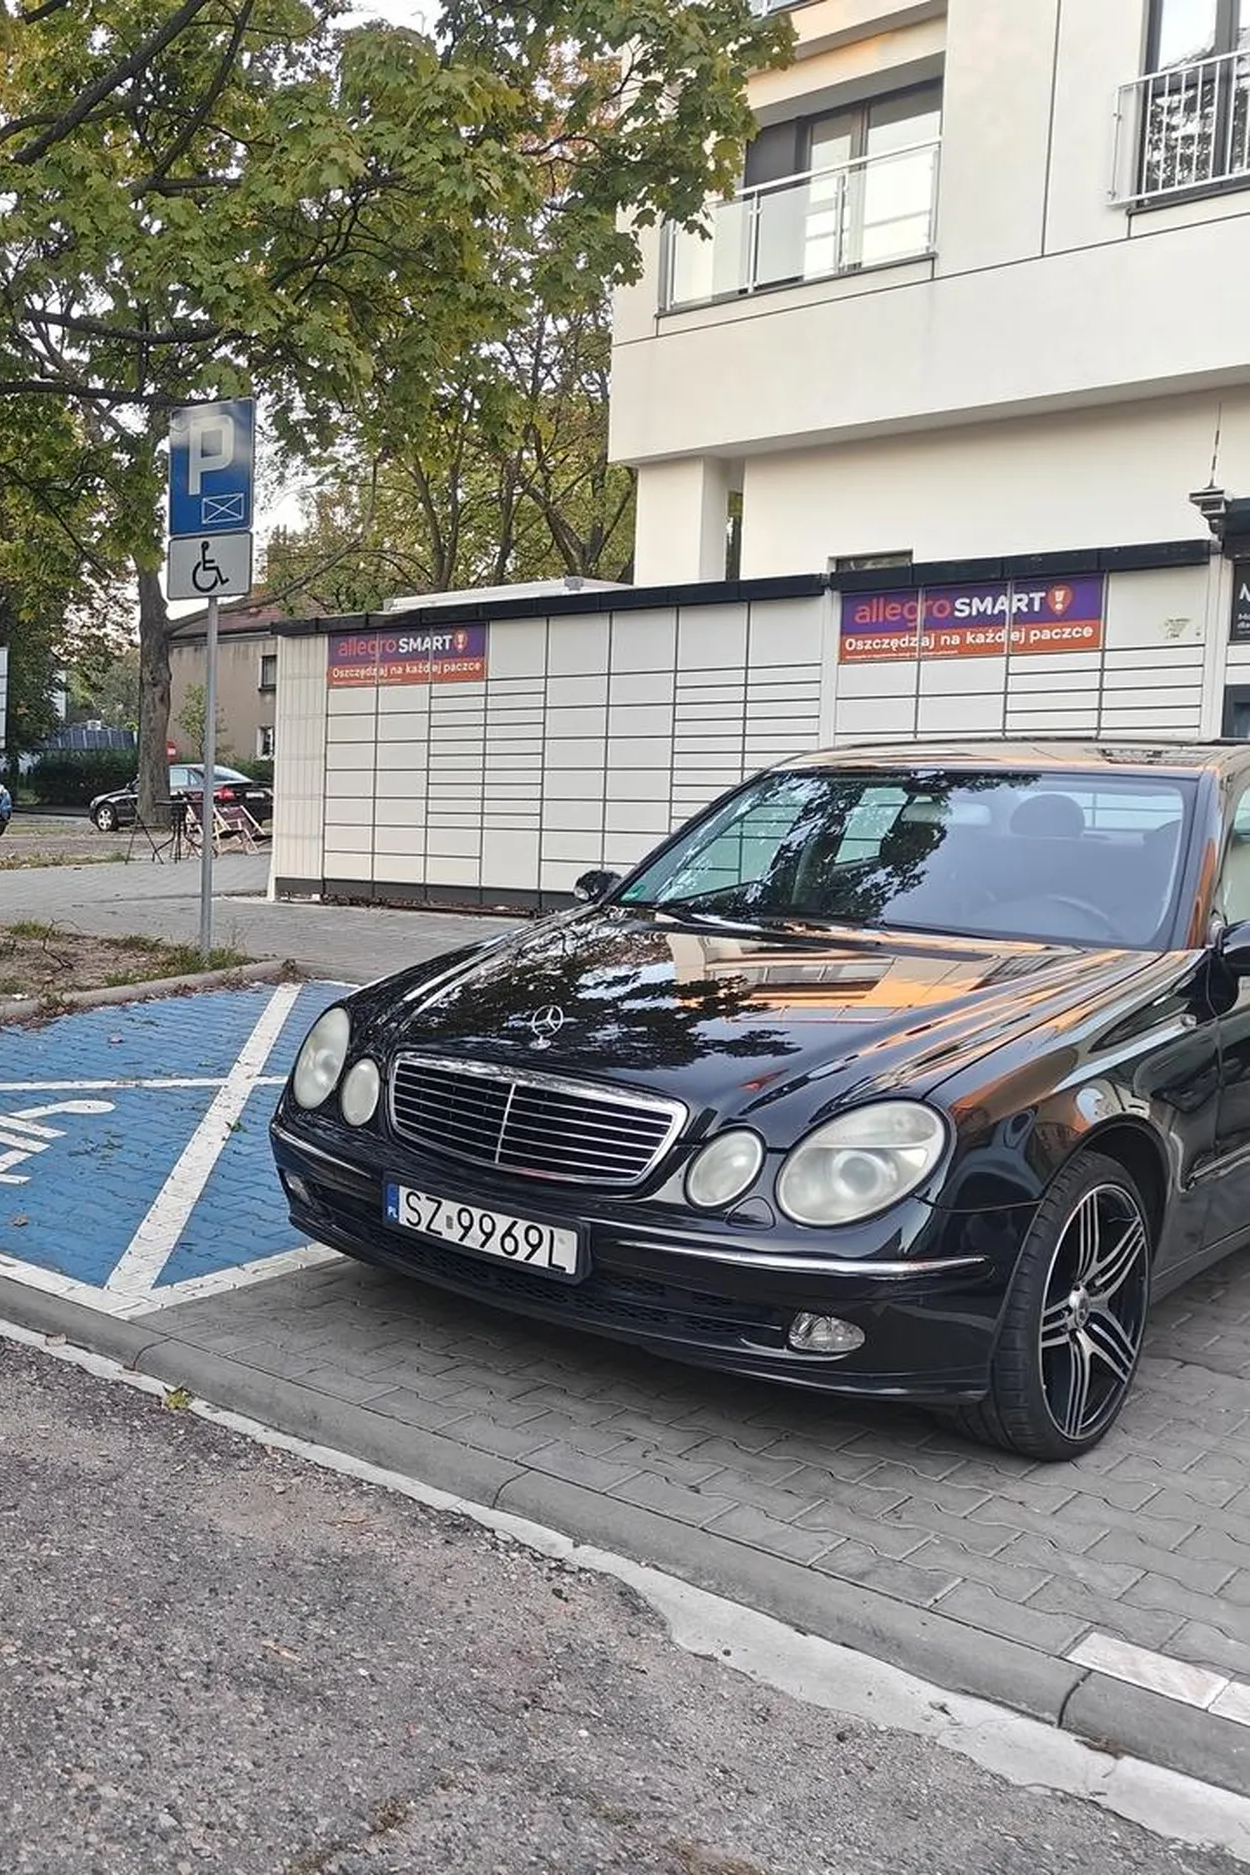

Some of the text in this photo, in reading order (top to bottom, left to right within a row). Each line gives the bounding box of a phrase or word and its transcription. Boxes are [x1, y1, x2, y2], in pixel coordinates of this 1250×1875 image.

[189, 414, 234, 496] P
[854, 591, 1046, 627] allegro SMART
[338, 635, 453, 661] allegro SMART
[844, 626, 1093, 651] Oszczędzaj na każdej paczce
[405, 1191, 568, 1271] SZ 9969L
